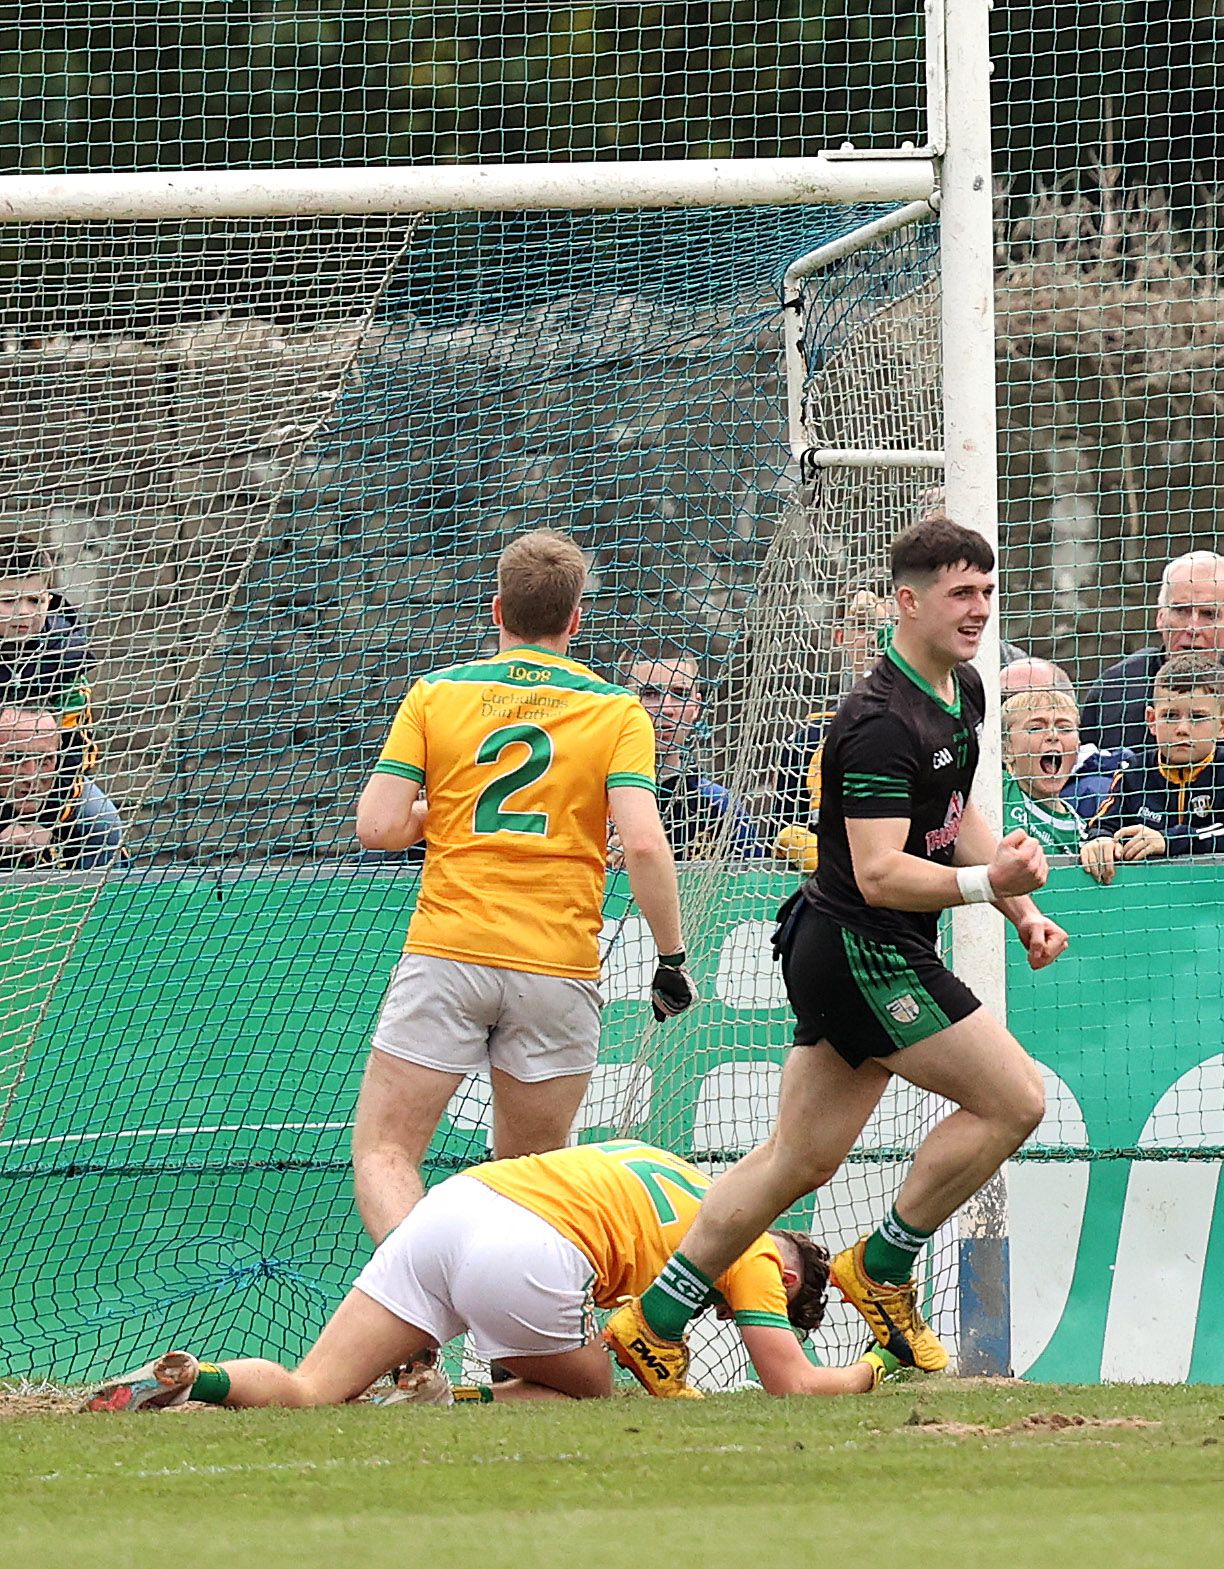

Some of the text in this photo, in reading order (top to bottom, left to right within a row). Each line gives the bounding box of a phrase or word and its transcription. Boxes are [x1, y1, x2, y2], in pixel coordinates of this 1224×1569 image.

[506, 665, 552, 683] 1908
[473, 723, 554, 837] 2
[628, 1337, 672, 1381] PWR
